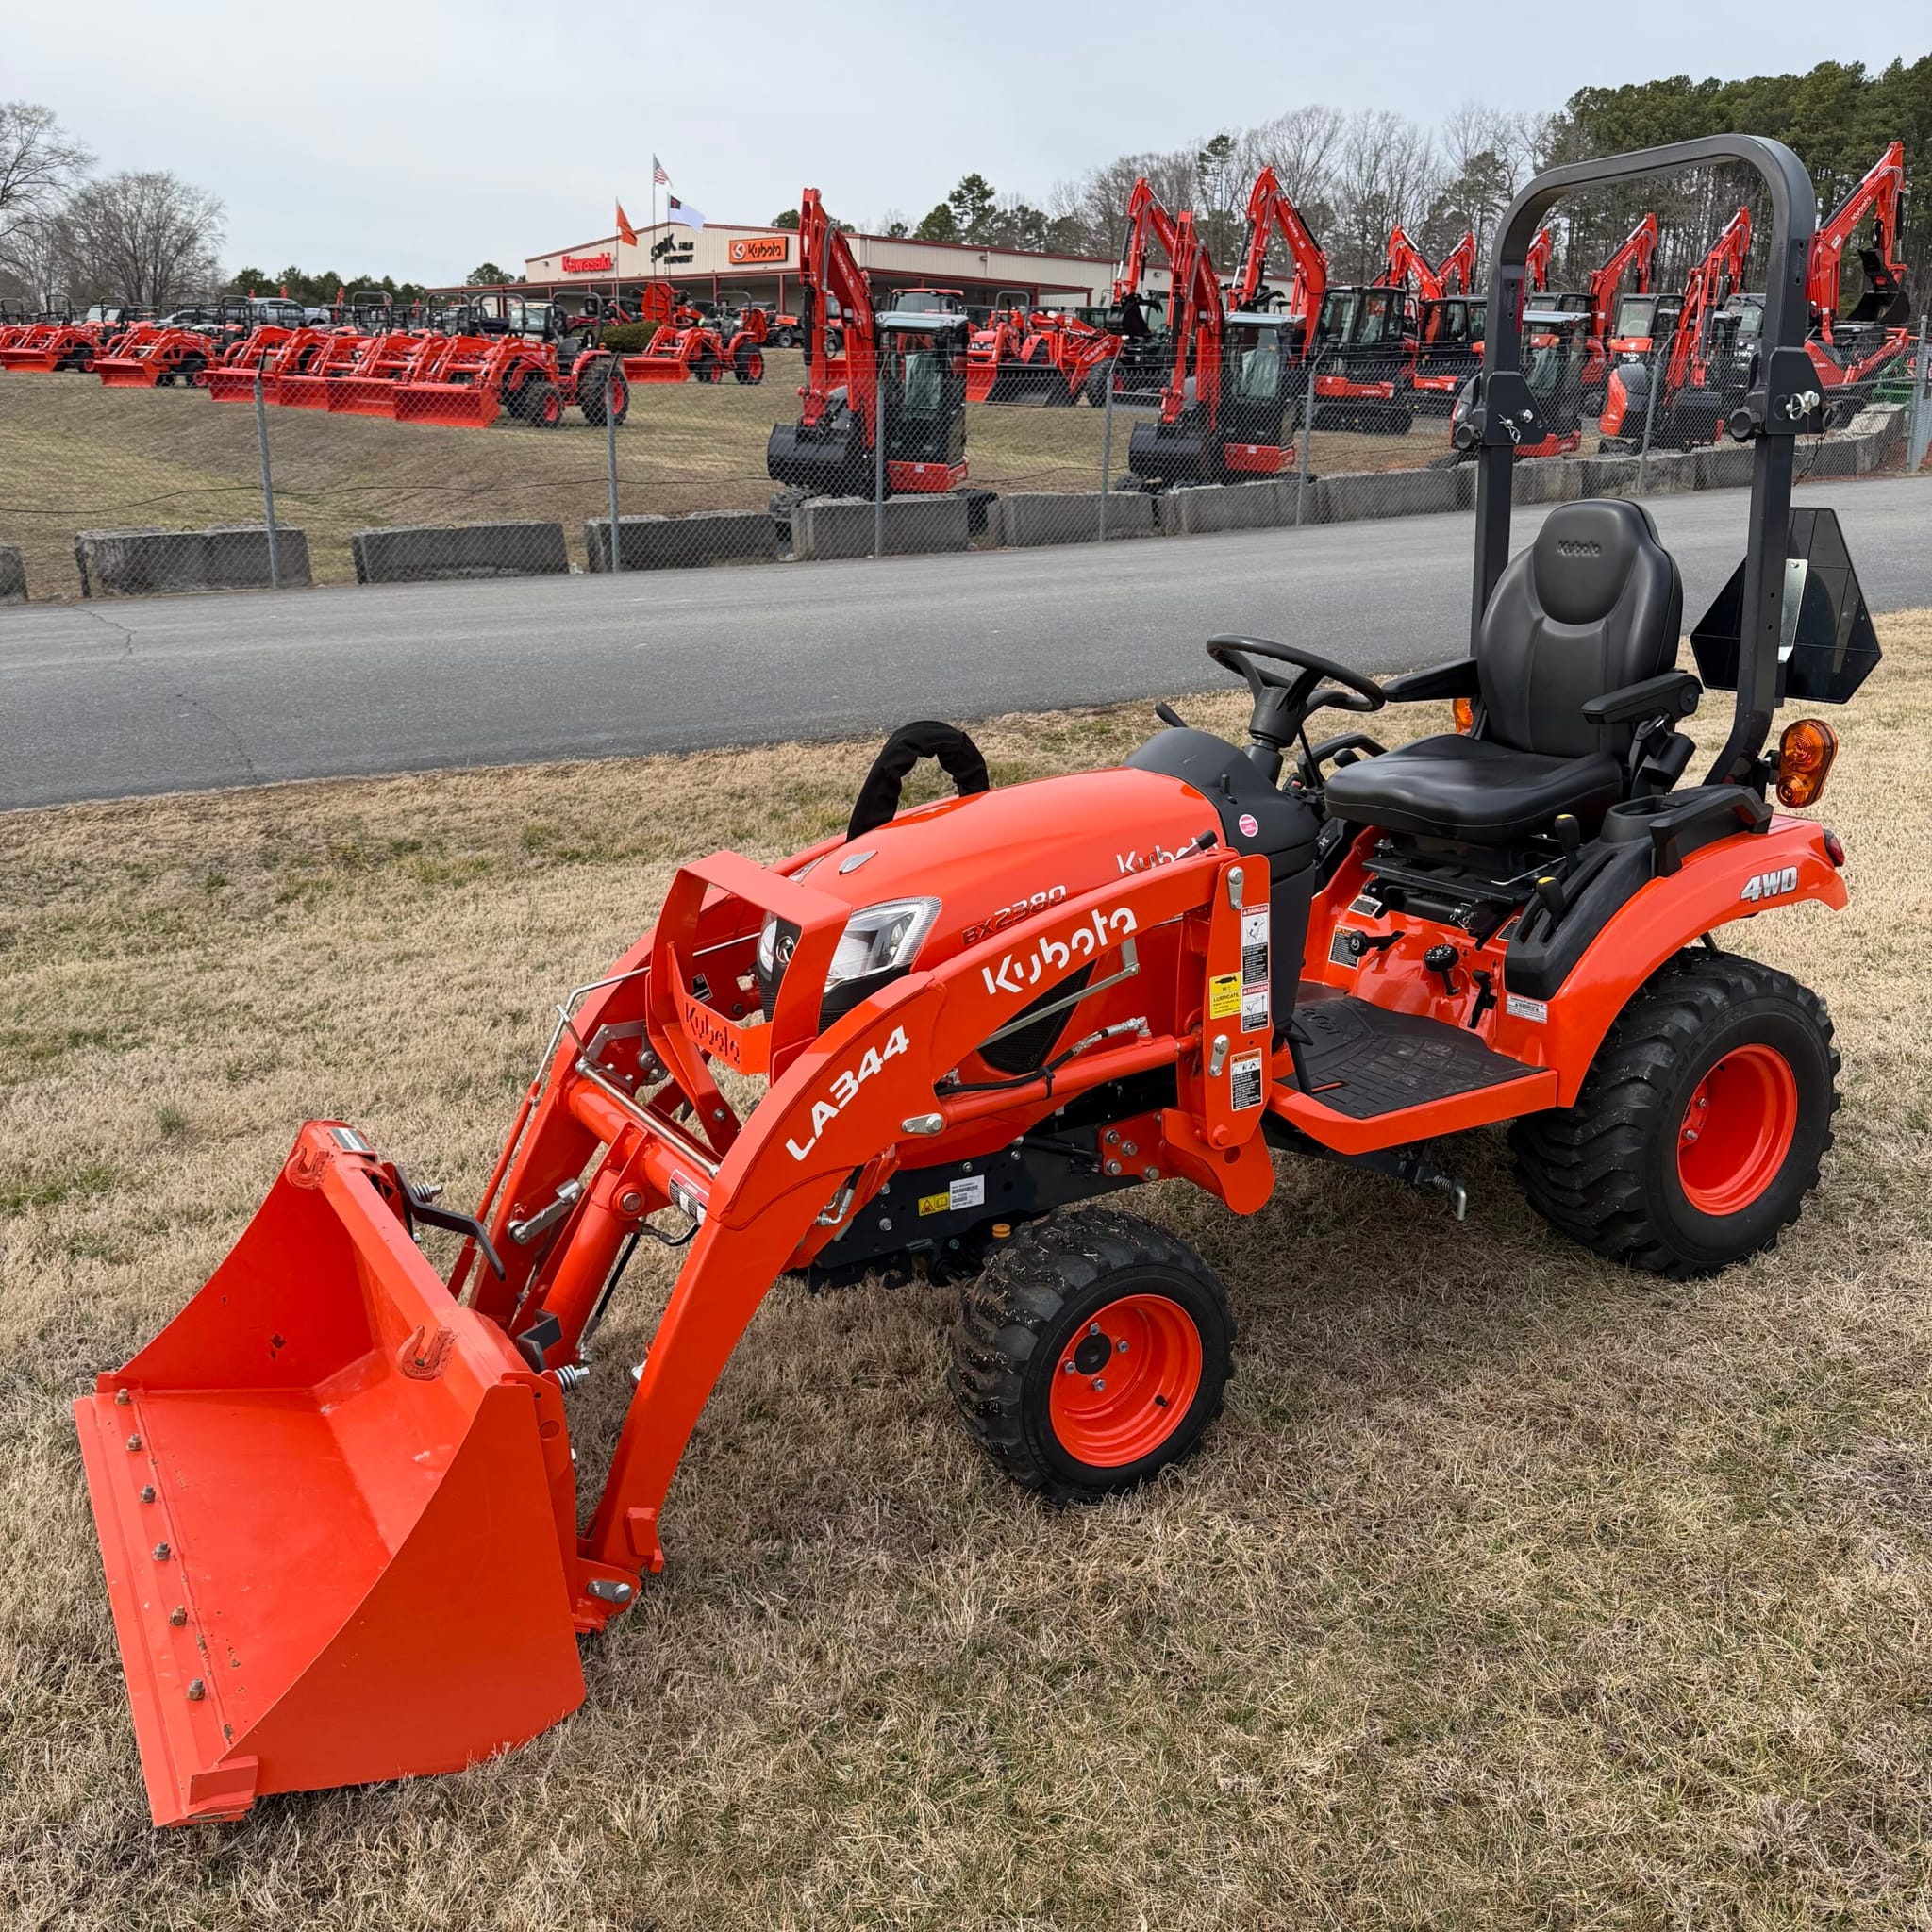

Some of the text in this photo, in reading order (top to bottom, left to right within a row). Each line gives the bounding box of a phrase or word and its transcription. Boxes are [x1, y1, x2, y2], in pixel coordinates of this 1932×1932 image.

[1850, 195, 1872, 221] Kubota
[748, 242, 782, 258] Kubota
[562, 252, 612, 272] Kawasaki
[1557, 539, 1601, 557] Kubota
[1740, 866, 1797, 902] 4WD
[962, 885, 1067, 944] BX2380
[1246, 906, 1268, 915] DANGER
[982, 907, 1138, 995] Kubota
[1213, 993, 1240, 1002] LUBRICATE
[1247, 984, 1268, 993] DANGER
[686, 1002, 741, 1065] Kubota
[785, 1025, 910, 1161] LA344
